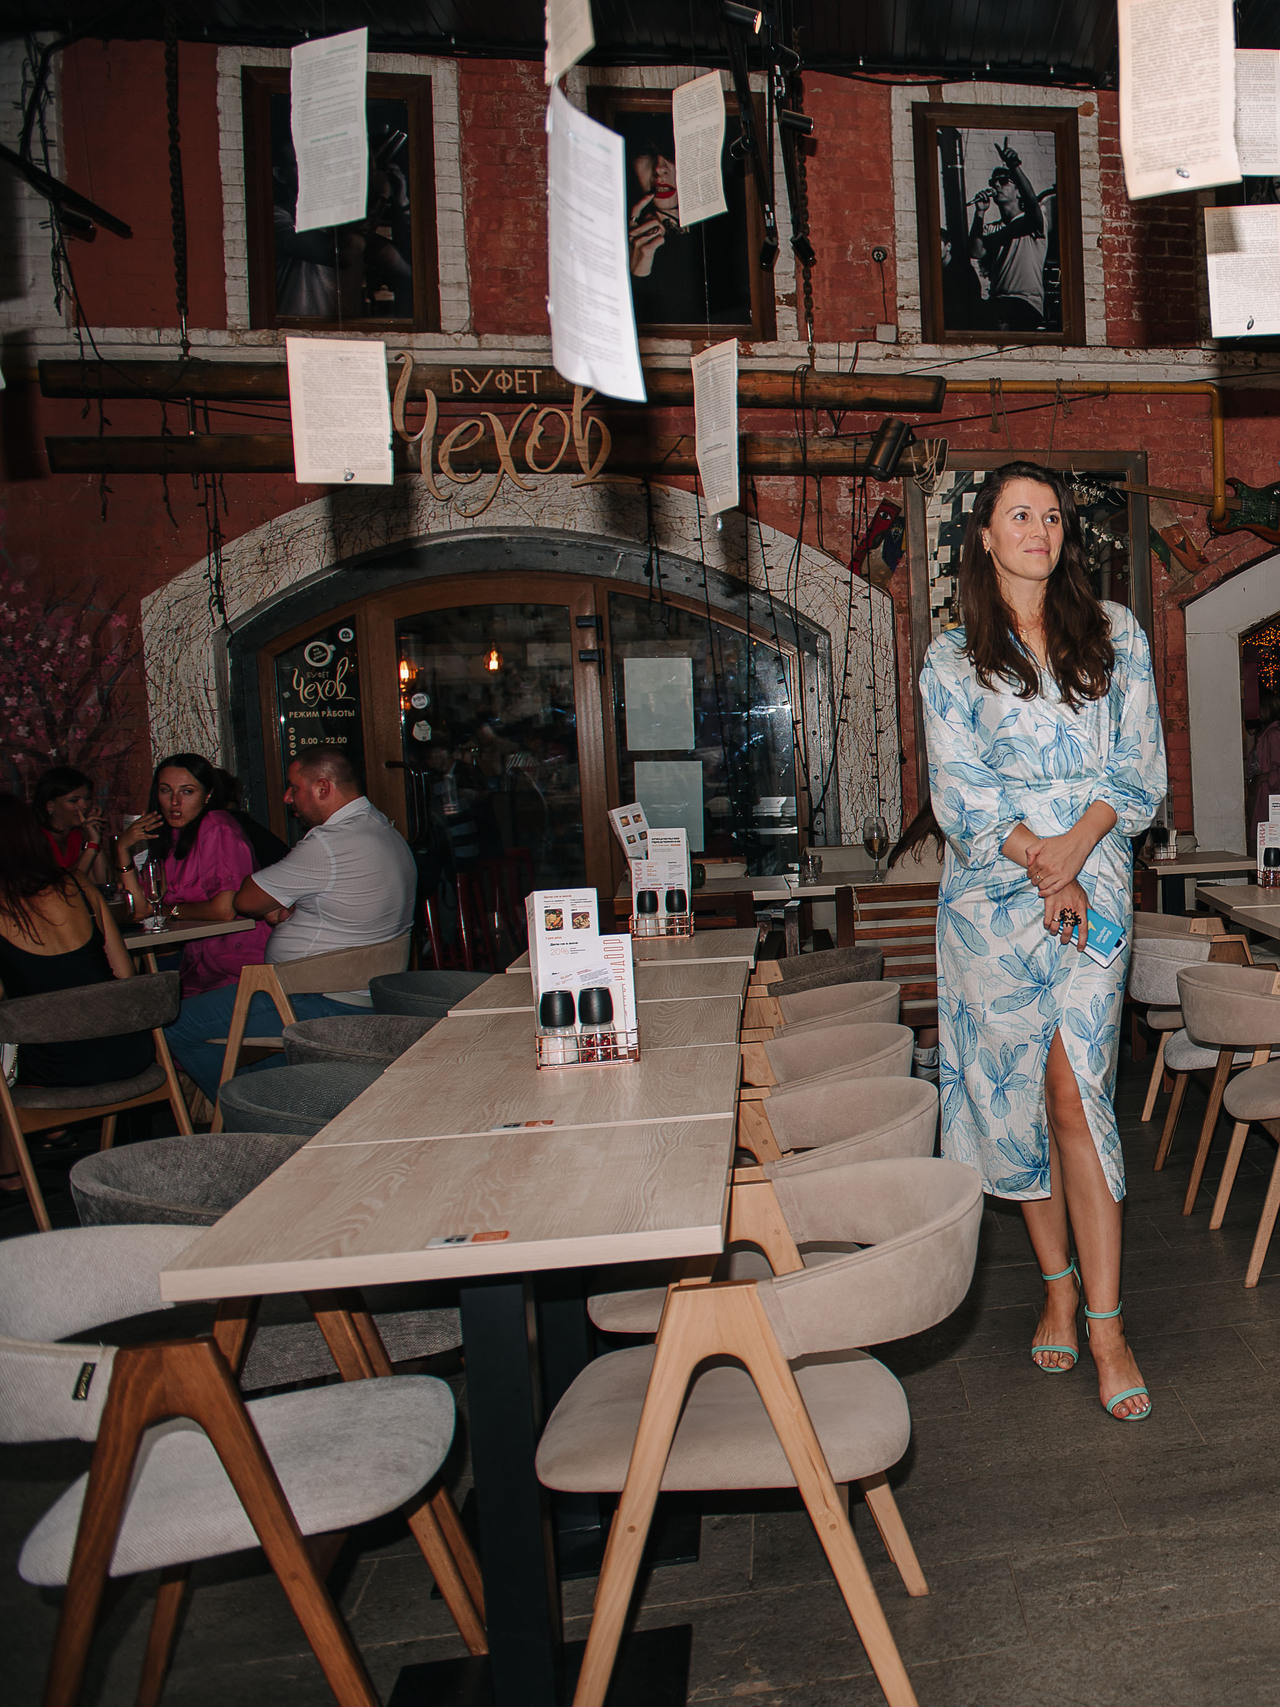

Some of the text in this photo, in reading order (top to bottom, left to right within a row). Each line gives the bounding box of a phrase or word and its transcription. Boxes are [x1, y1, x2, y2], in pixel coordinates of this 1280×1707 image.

[451, 369, 542, 394] БУФЕТ
[321, 710, 355, 718] РАБОТЫ
[300, 737, 318, 745] 8.00
[325, 736, 347, 745] 22.00
